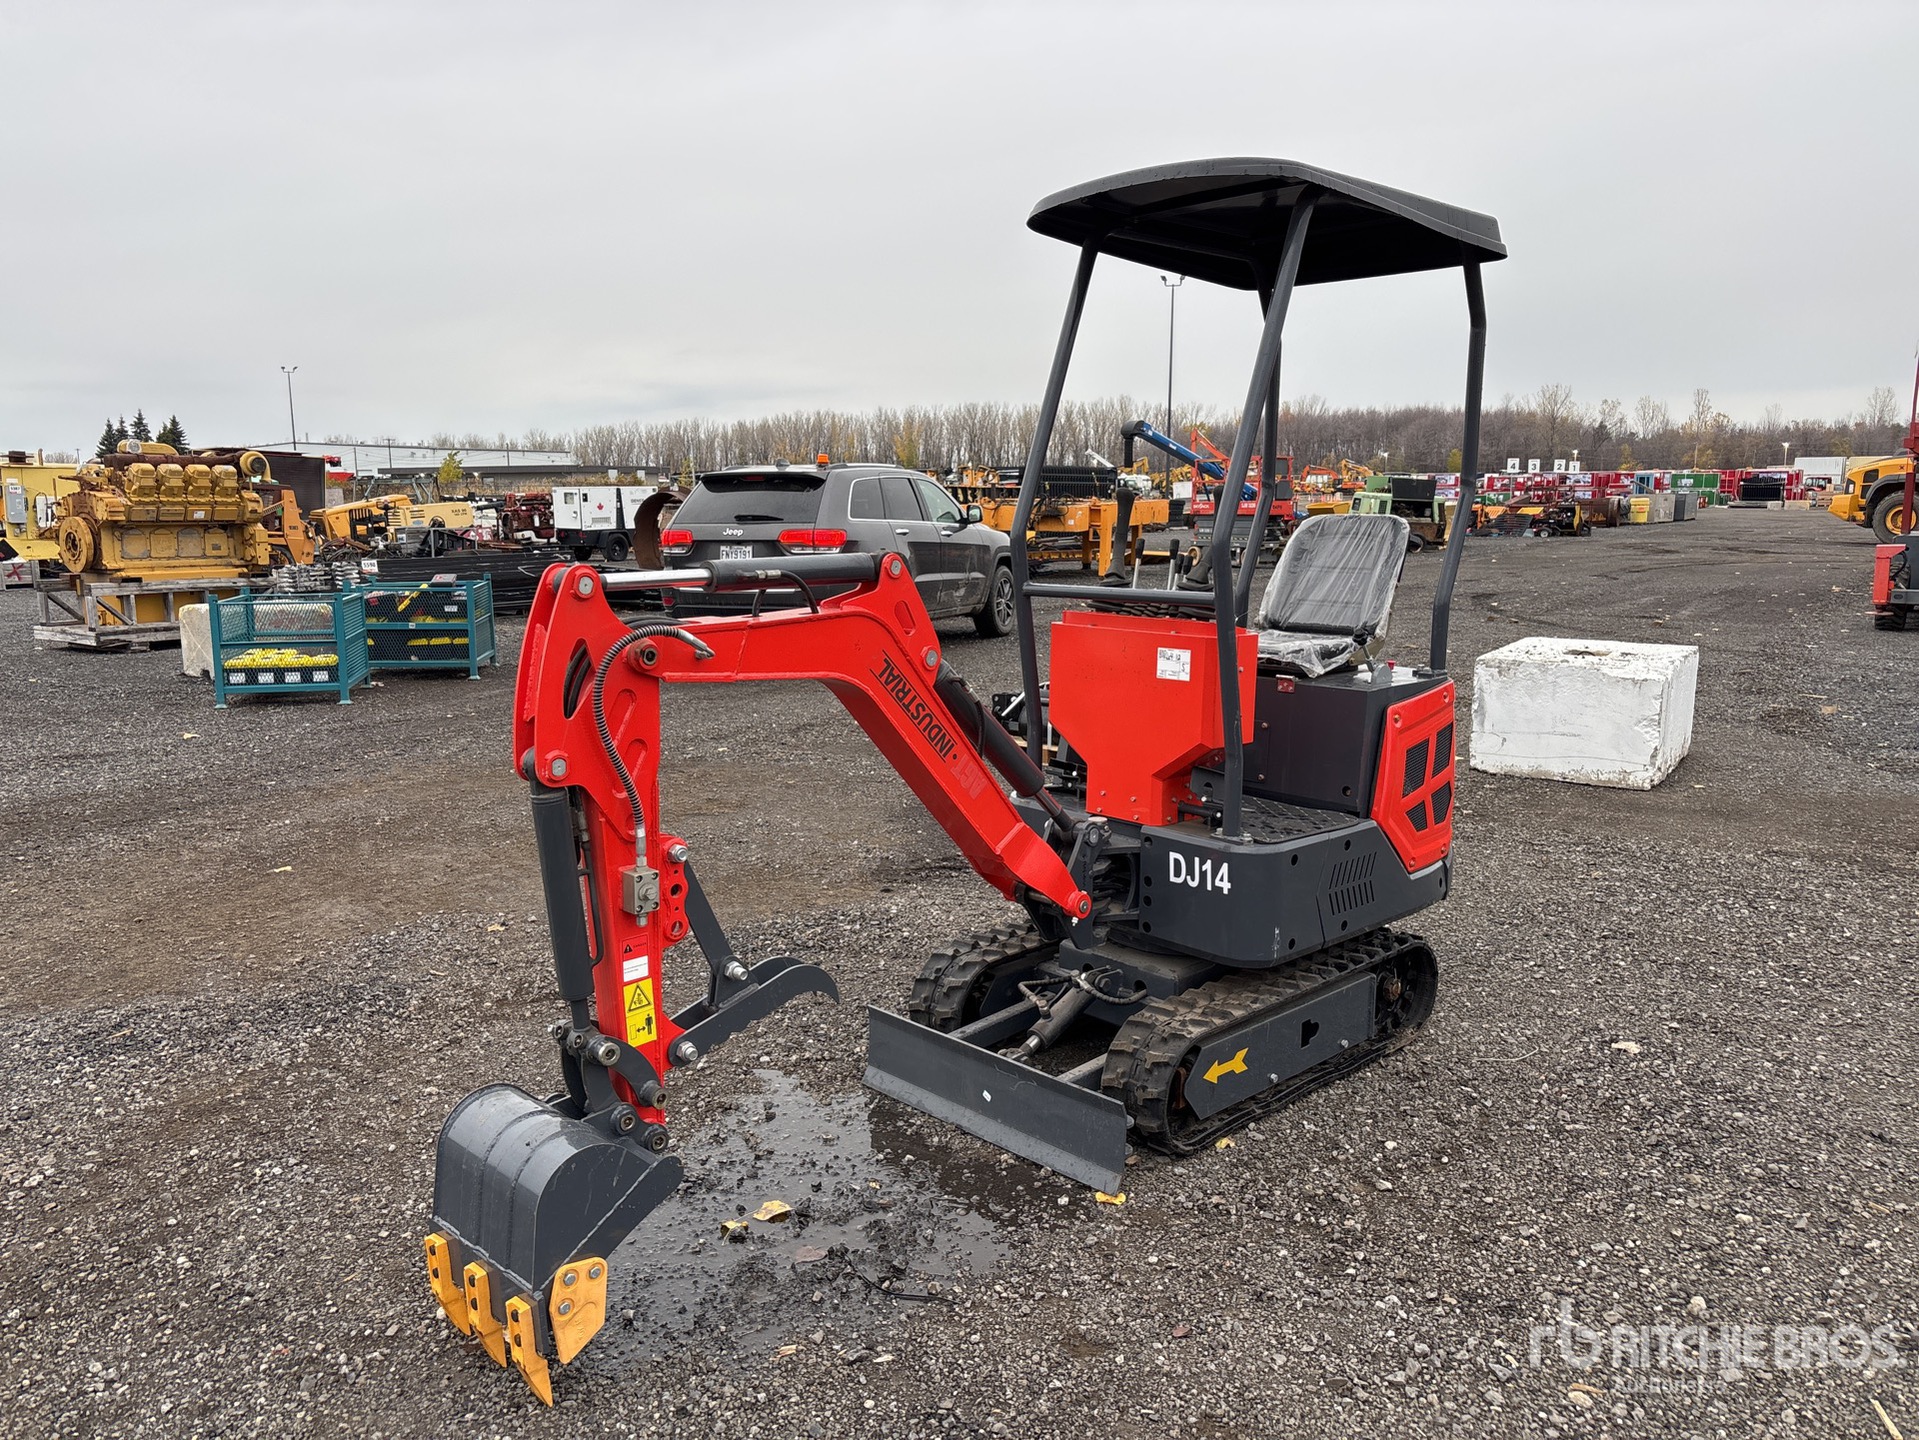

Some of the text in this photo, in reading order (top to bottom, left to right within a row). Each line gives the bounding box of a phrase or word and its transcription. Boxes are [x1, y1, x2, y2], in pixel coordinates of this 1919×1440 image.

[722, 528, 744, 537] Jeep
[878, 657, 957, 759] INDUSTRIAL
[1169, 851, 1232, 895] DJ14
